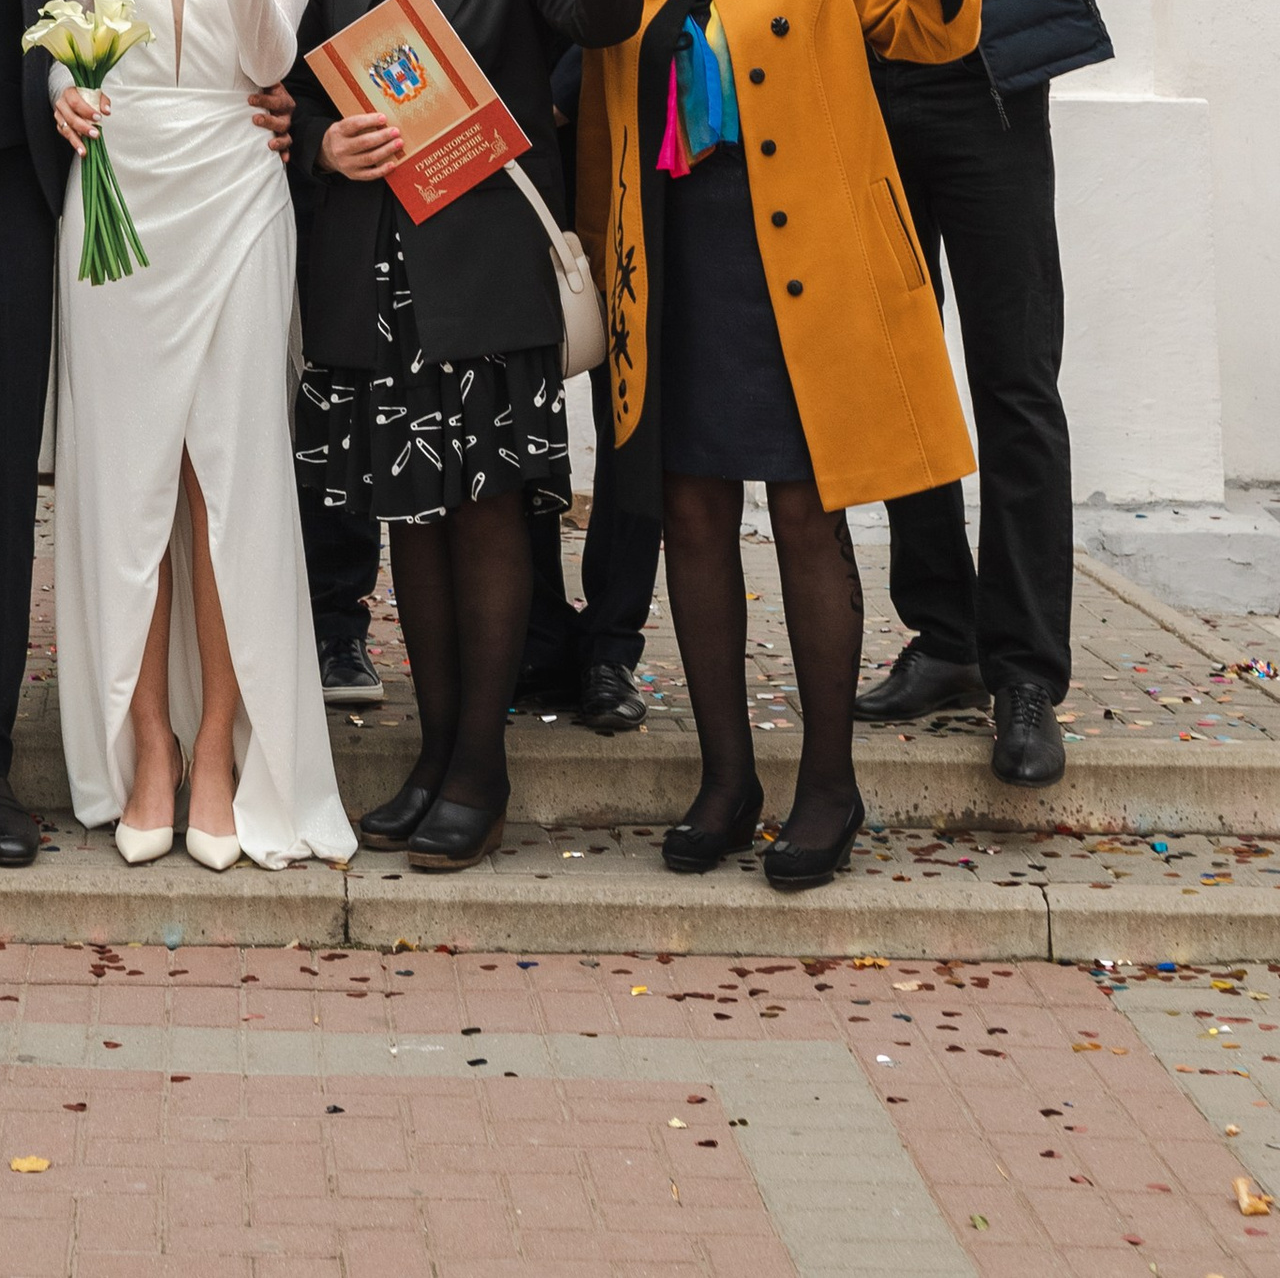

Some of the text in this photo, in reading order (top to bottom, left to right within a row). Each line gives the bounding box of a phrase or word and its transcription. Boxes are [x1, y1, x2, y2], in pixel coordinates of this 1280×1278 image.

[414, 122, 483, 172] ГУБЕРНАТОРСКОЕ
[424, 133, 484, 178] ПОЗДРАВЛЕНИЕ
[428, 140, 490, 185] МОЛОДОЖЕНАМ
